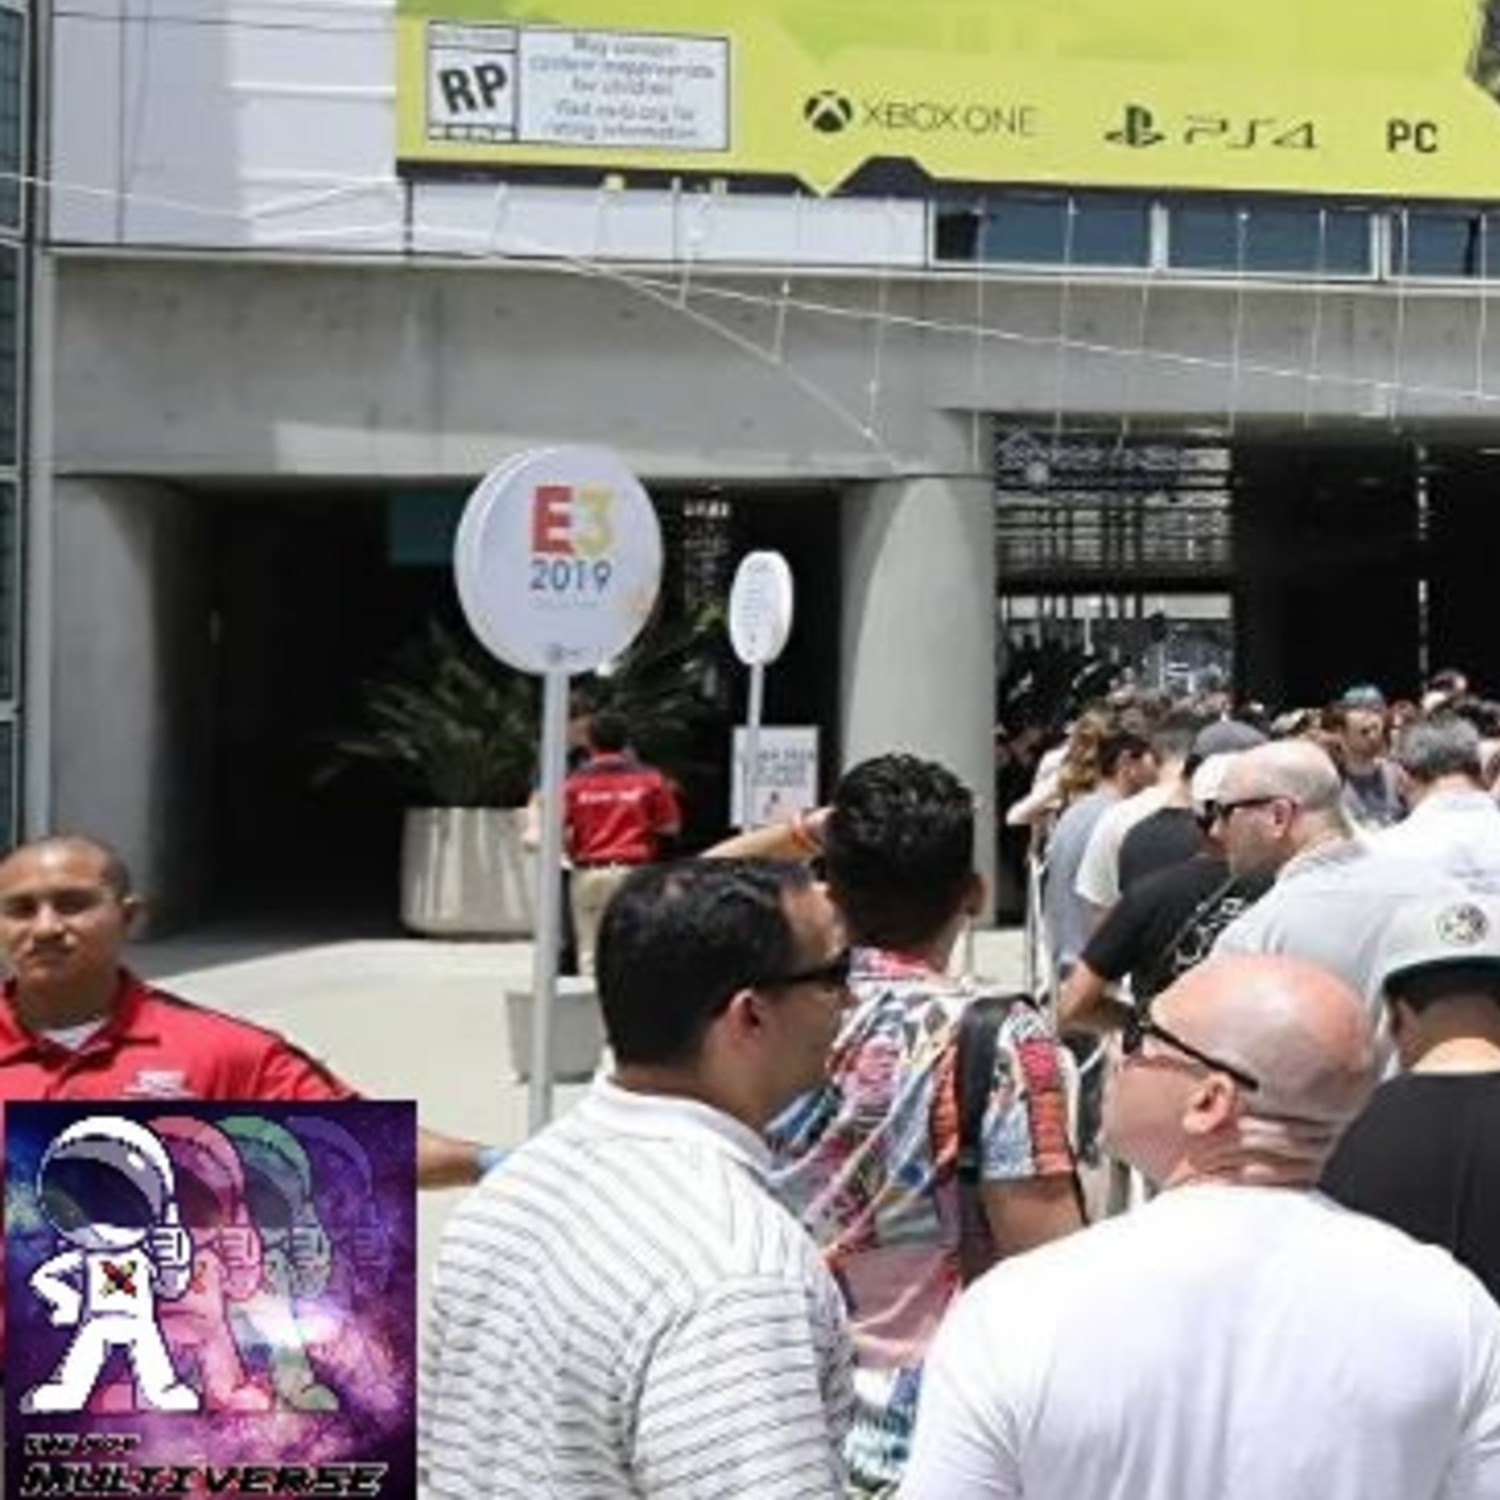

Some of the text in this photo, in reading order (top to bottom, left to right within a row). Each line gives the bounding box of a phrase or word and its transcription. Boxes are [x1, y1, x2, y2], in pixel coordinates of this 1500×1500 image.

[438, 62, 508, 115] RP
[863, 100, 1044, 137] XBOX ONE
[1184, 114, 1317, 149] PS4
[1386, 118, 1438, 153] PC
[532, 485, 617, 556] E3
[530, 558, 612, 594] 2019
